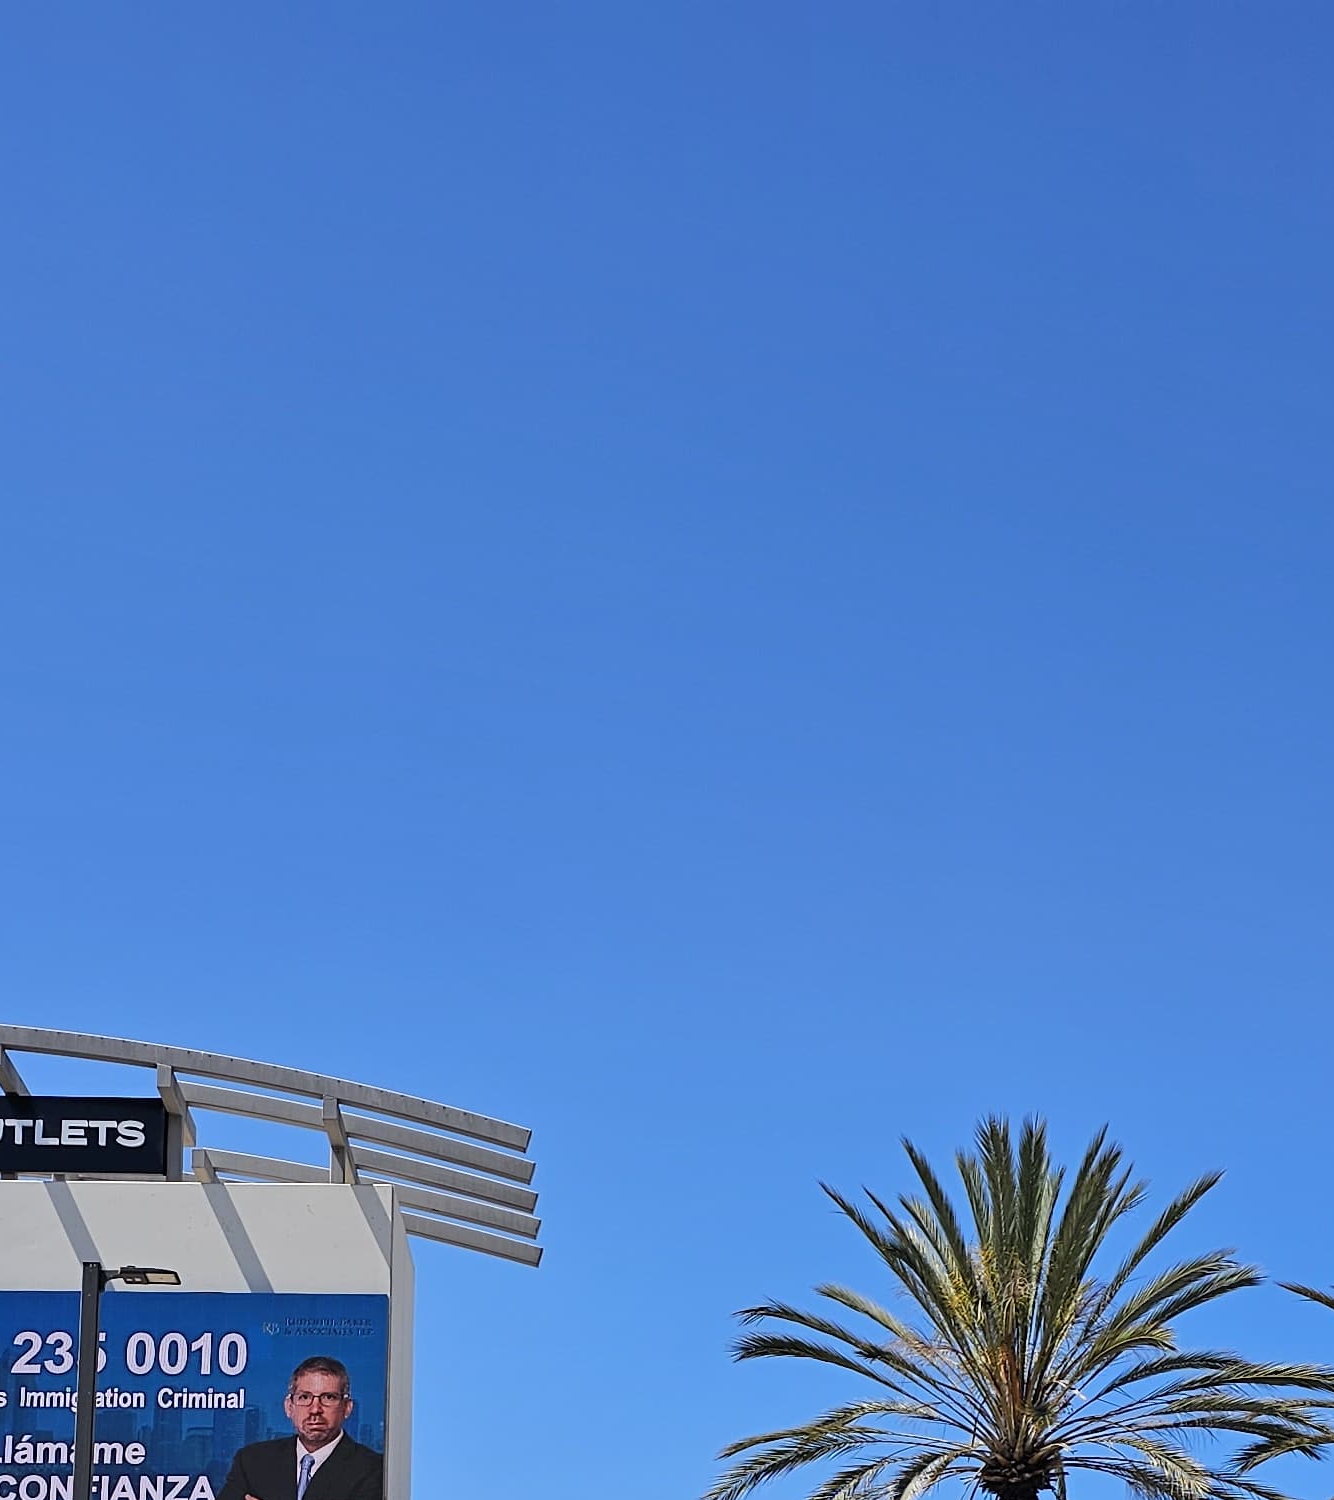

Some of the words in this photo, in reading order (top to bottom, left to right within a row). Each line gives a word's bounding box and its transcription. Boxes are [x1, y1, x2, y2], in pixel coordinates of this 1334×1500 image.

[126, 1332, 248, 1376] 0010
[20, 1387, 145, 1413] Immigation
[158, 1388, 245, 1409] Criminal
